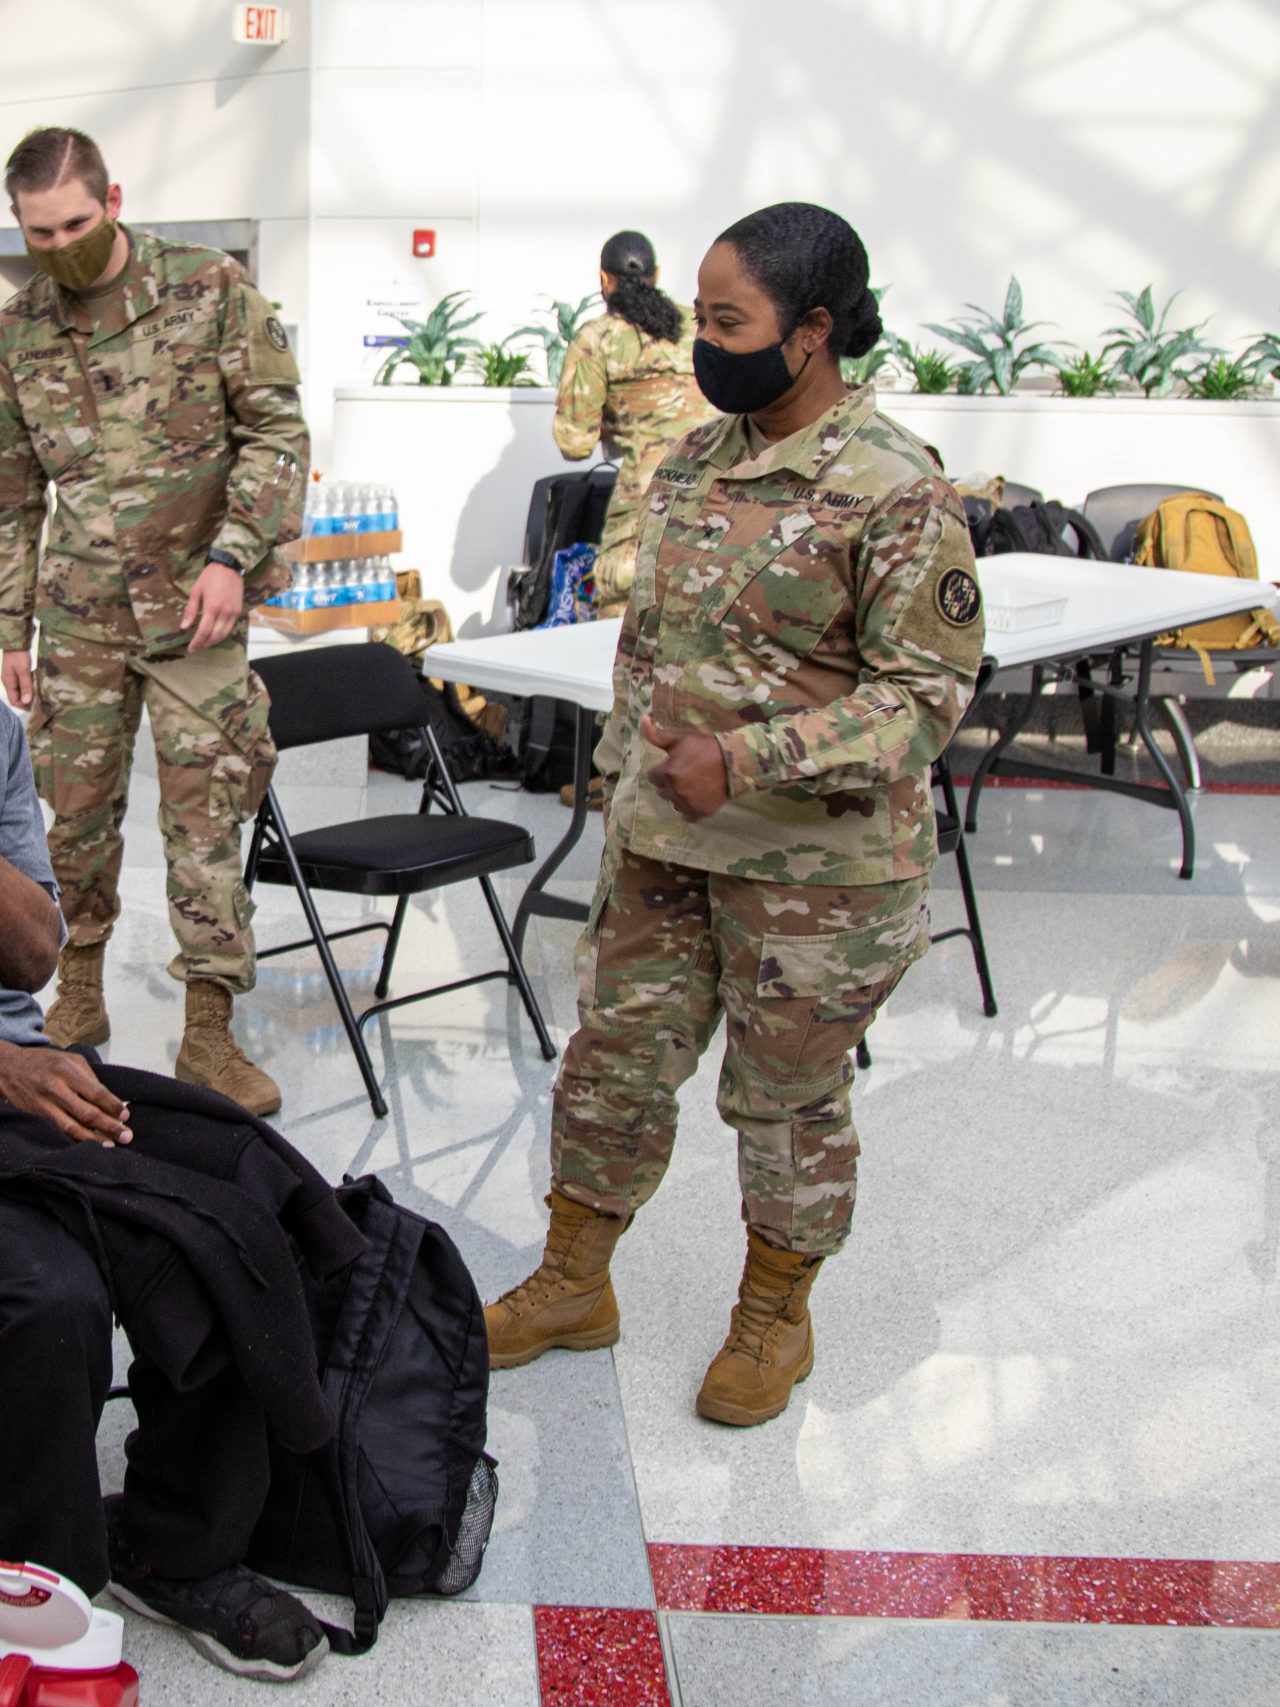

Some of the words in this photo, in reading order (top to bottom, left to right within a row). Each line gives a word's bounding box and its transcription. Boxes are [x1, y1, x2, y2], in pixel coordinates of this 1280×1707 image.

[246, 8, 277, 40] EXIT
[164, 311, 194, 328] ARMY
[820, 490, 865, 509] ARMY
